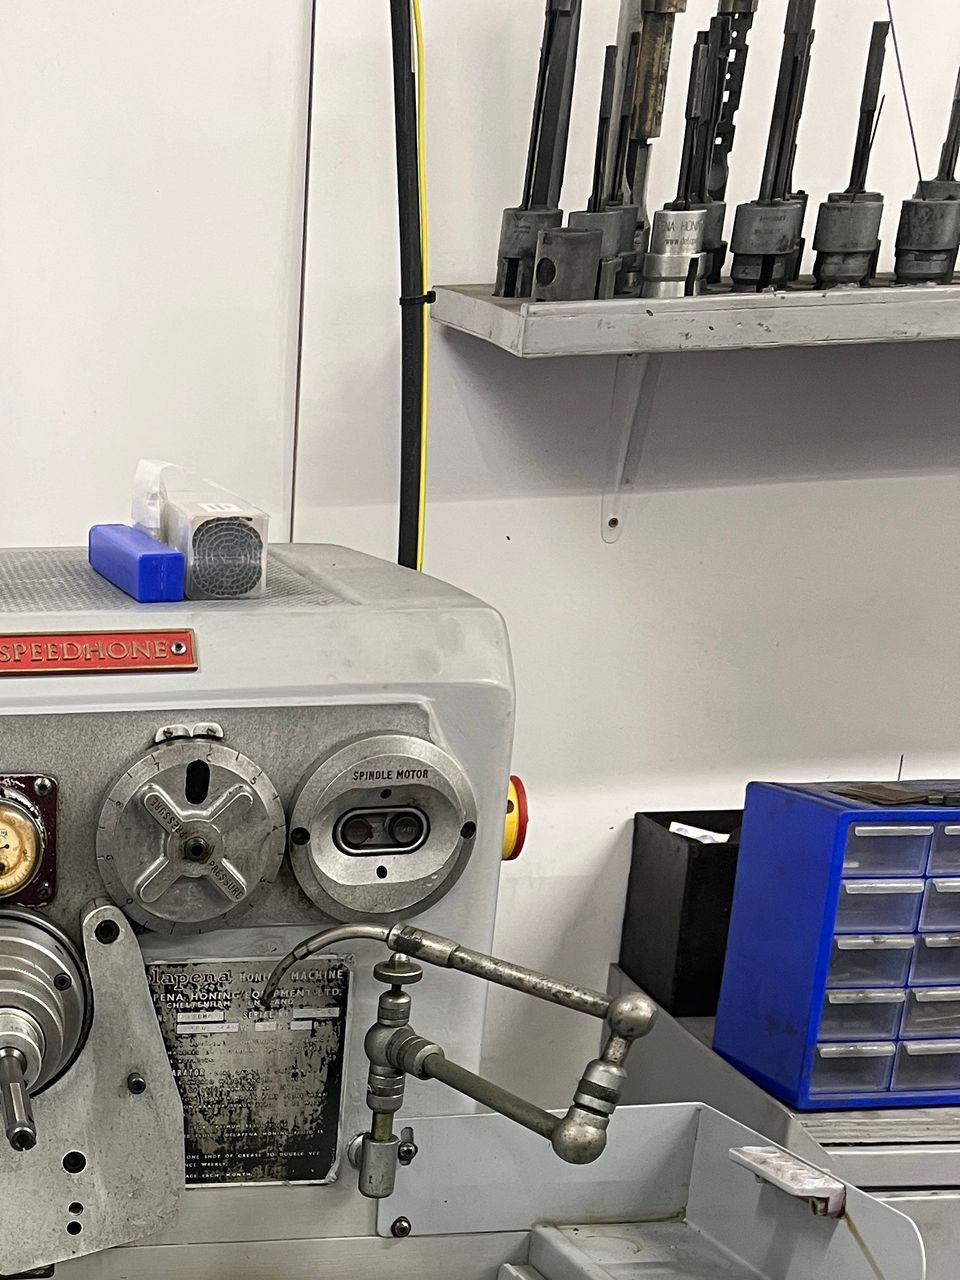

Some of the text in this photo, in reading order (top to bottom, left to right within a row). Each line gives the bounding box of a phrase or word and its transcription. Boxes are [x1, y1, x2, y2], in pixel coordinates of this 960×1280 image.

[352, 769, 429, 781] SPINDLE MOTOR
[149, 798, 188, 840] PRESSURE
[208, 860, 245, 900] PRESSURE
[147, 968, 233, 991] lapena
[290, 969, 344, 980] MACHINE
[153, 993, 184, 1002] PENA
[191, 991, 241, 1001] HONING
[172, 1068, 205, 1077] ARATOR
